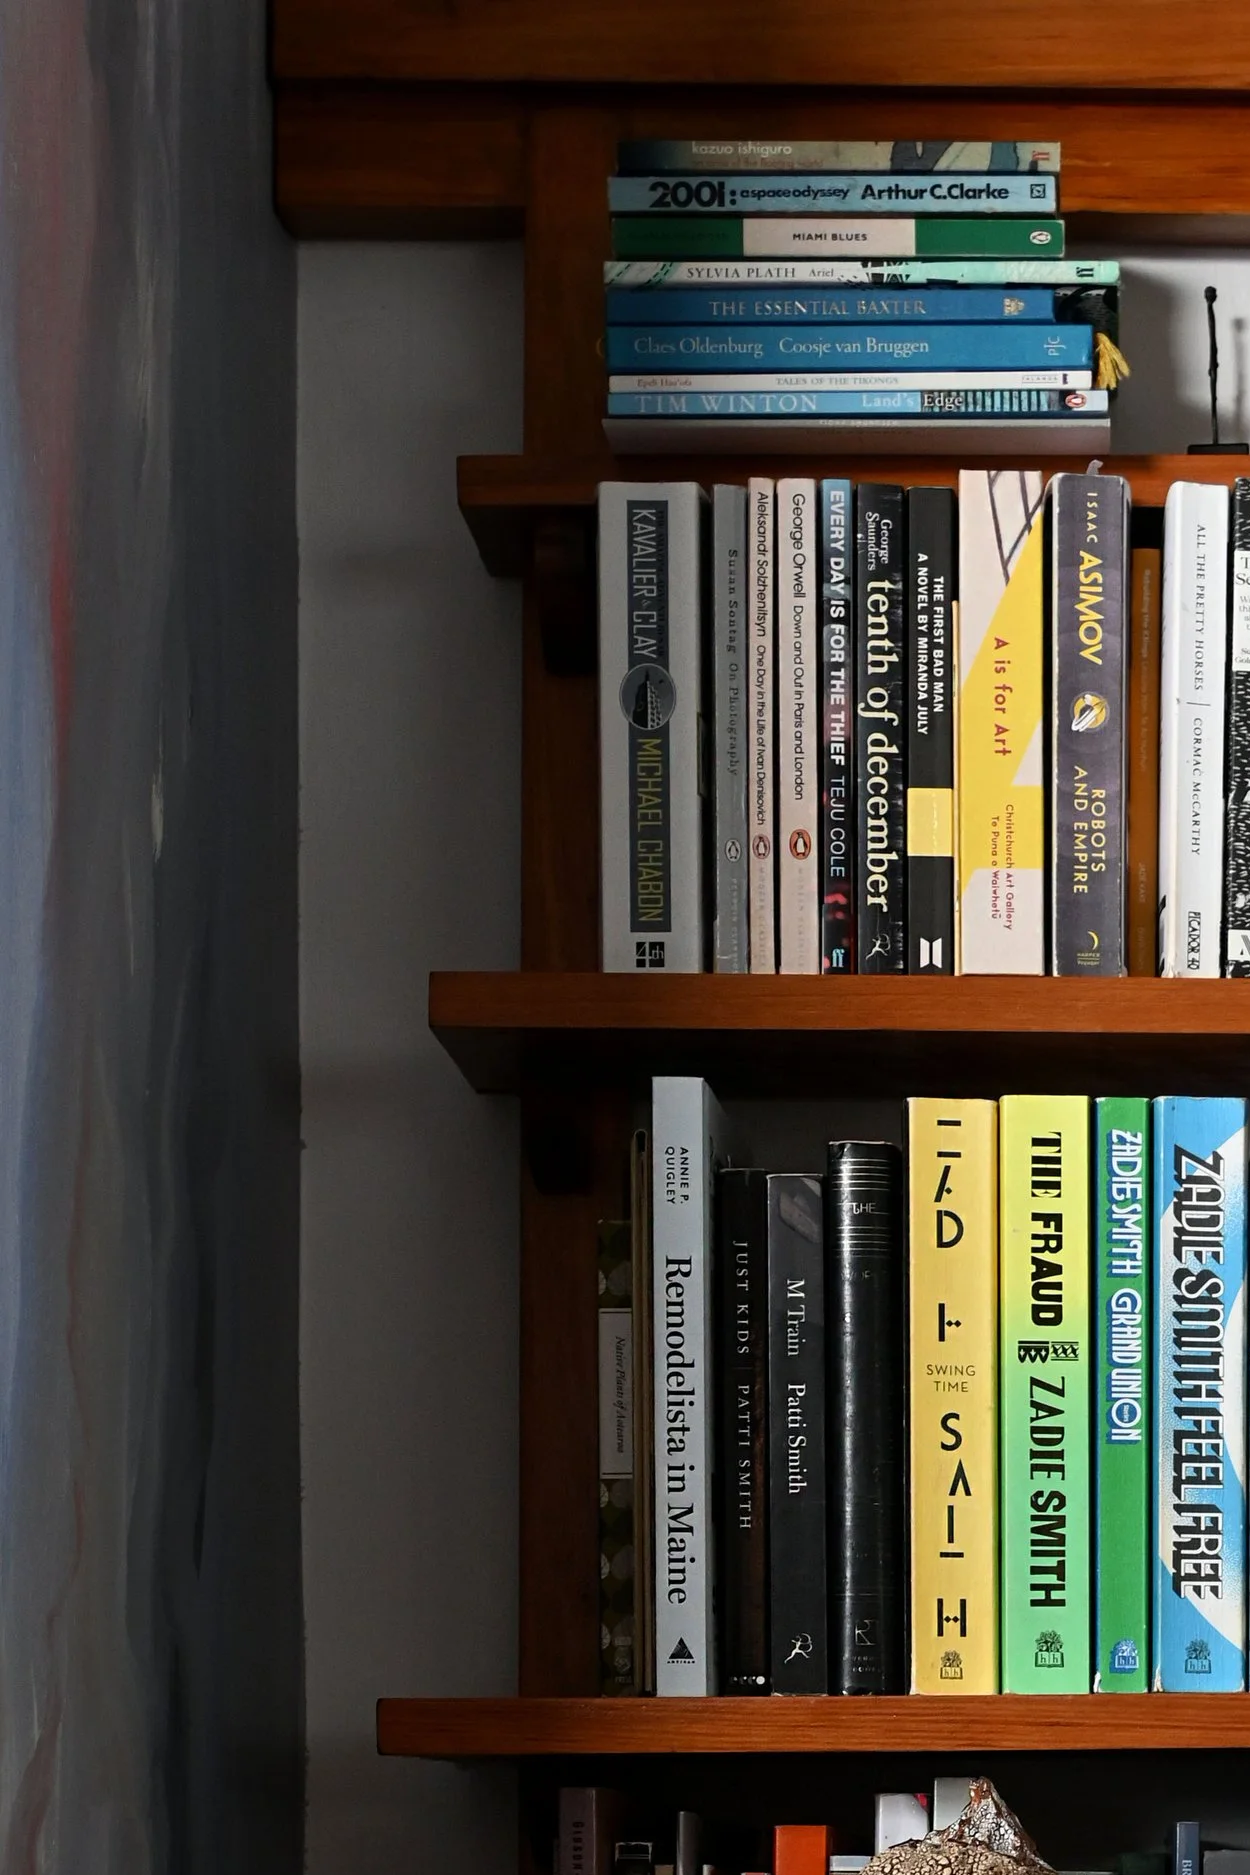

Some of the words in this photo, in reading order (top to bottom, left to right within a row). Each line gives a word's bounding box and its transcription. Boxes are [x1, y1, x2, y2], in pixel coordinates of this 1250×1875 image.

[860, 183, 928, 200] Arthur
[792, 233, 827, 241] MIAMI
[831, 233, 868, 242] BLUES
[686, 267, 741, 279] SYLVIA
[746, 267, 796, 279] PLATH
[808, 267, 836, 279] Ariel
[709, 299, 745, 316] THE
[754, 300, 851, 317] ESSENTIAL
[857, 300, 927, 315] BAXTER
[634, 393, 688, 413] TIM
[700, 392, 819, 413] WINTON
[922, 392, 964, 411] Edge
[789, 493, 806, 551] George
[829, 490, 845, 552] EVERY
[876, 515, 893, 564] George
[1086, 492, 1098, 543] ISAAC
[1196, 524, 1206, 549] ALL
[631, 508, 658, 598] KAVALIER
[863, 511, 881, 571] Saunders
[917, 552, 929, 562] A
[792, 552, 807, 598] Orwell
[829, 556, 845, 596] DAY
[917, 567, 929, 610] NOVEL
[933, 575, 945, 602] THE
[1196, 553, 1206, 580] THE
[793, 605, 804, 639] Down
[829, 600, 845, 619] IS
[866, 579, 901, 675] tenth
[917, 614, 929, 633] BY
[933, 606, 945, 645] FIRST
[1072, 550, 1105, 666] ASIMOV
[1195, 584, 1206, 633] PRETTY
[631, 610, 658, 659] CLAY
[793, 640, 805, 665] and
[829, 624, 845, 664] FOR
[994, 636, 1010, 650] A
[793, 667, 805, 689] Out
[917, 637, 929, 701] MIRANDA
[932, 649, 944, 677] BAD
[994, 660, 1011, 674] is
[1194, 639, 1205, 691] HORSES
[794, 690, 805, 701] in
[828, 668, 845, 706] THE
[857, 686, 899, 727] of
[933, 681, 944, 713] MAN
[994, 683, 1014, 714] for
[793, 702, 805, 729] Paris
[828, 710, 845, 766] THIEF
[917, 704, 929, 735] JULY
[793, 730, 805, 755] and
[994, 723, 1012, 757] Art
[1192, 717, 1203, 776] CORMAC
[636, 738, 663, 833] MICHAEL
[794, 756, 805, 801] London
[829, 775, 845, 821] TEJU
[1073, 765, 1089, 811] AND
[865, 732, 901, 913] december
[1089, 789, 1106, 872] ROBOTS
[1191, 781, 1201, 856] McCARTHY
[828, 827, 846, 878] COLE
[1073, 822, 1089, 894] EMPIRE
[637, 839, 664, 922] CHABON
[1029, 1131, 1066, 1200] THE
[732, 1240, 749, 1292] JUST
[786, 1279, 806, 1299] M
[1029, 1211, 1064, 1328] FRAUD
[736, 1303, 750, 1354] KIDS
[787, 1304, 806, 1356] Train
[665, 1255, 696, 1457] Remodelista
[737, 1384, 751, 1446] PATTI
[787, 1383, 807, 1429] Patti
[1029, 1375, 1066, 1481] ZADIE
[667, 1463, 695, 1495] in
[787, 1435, 808, 1494] Smith
[738, 1459, 752, 1529] SMITH
[667, 1502, 696, 1604] Maine
[1026, 1490, 1069, 1609] SMITH
